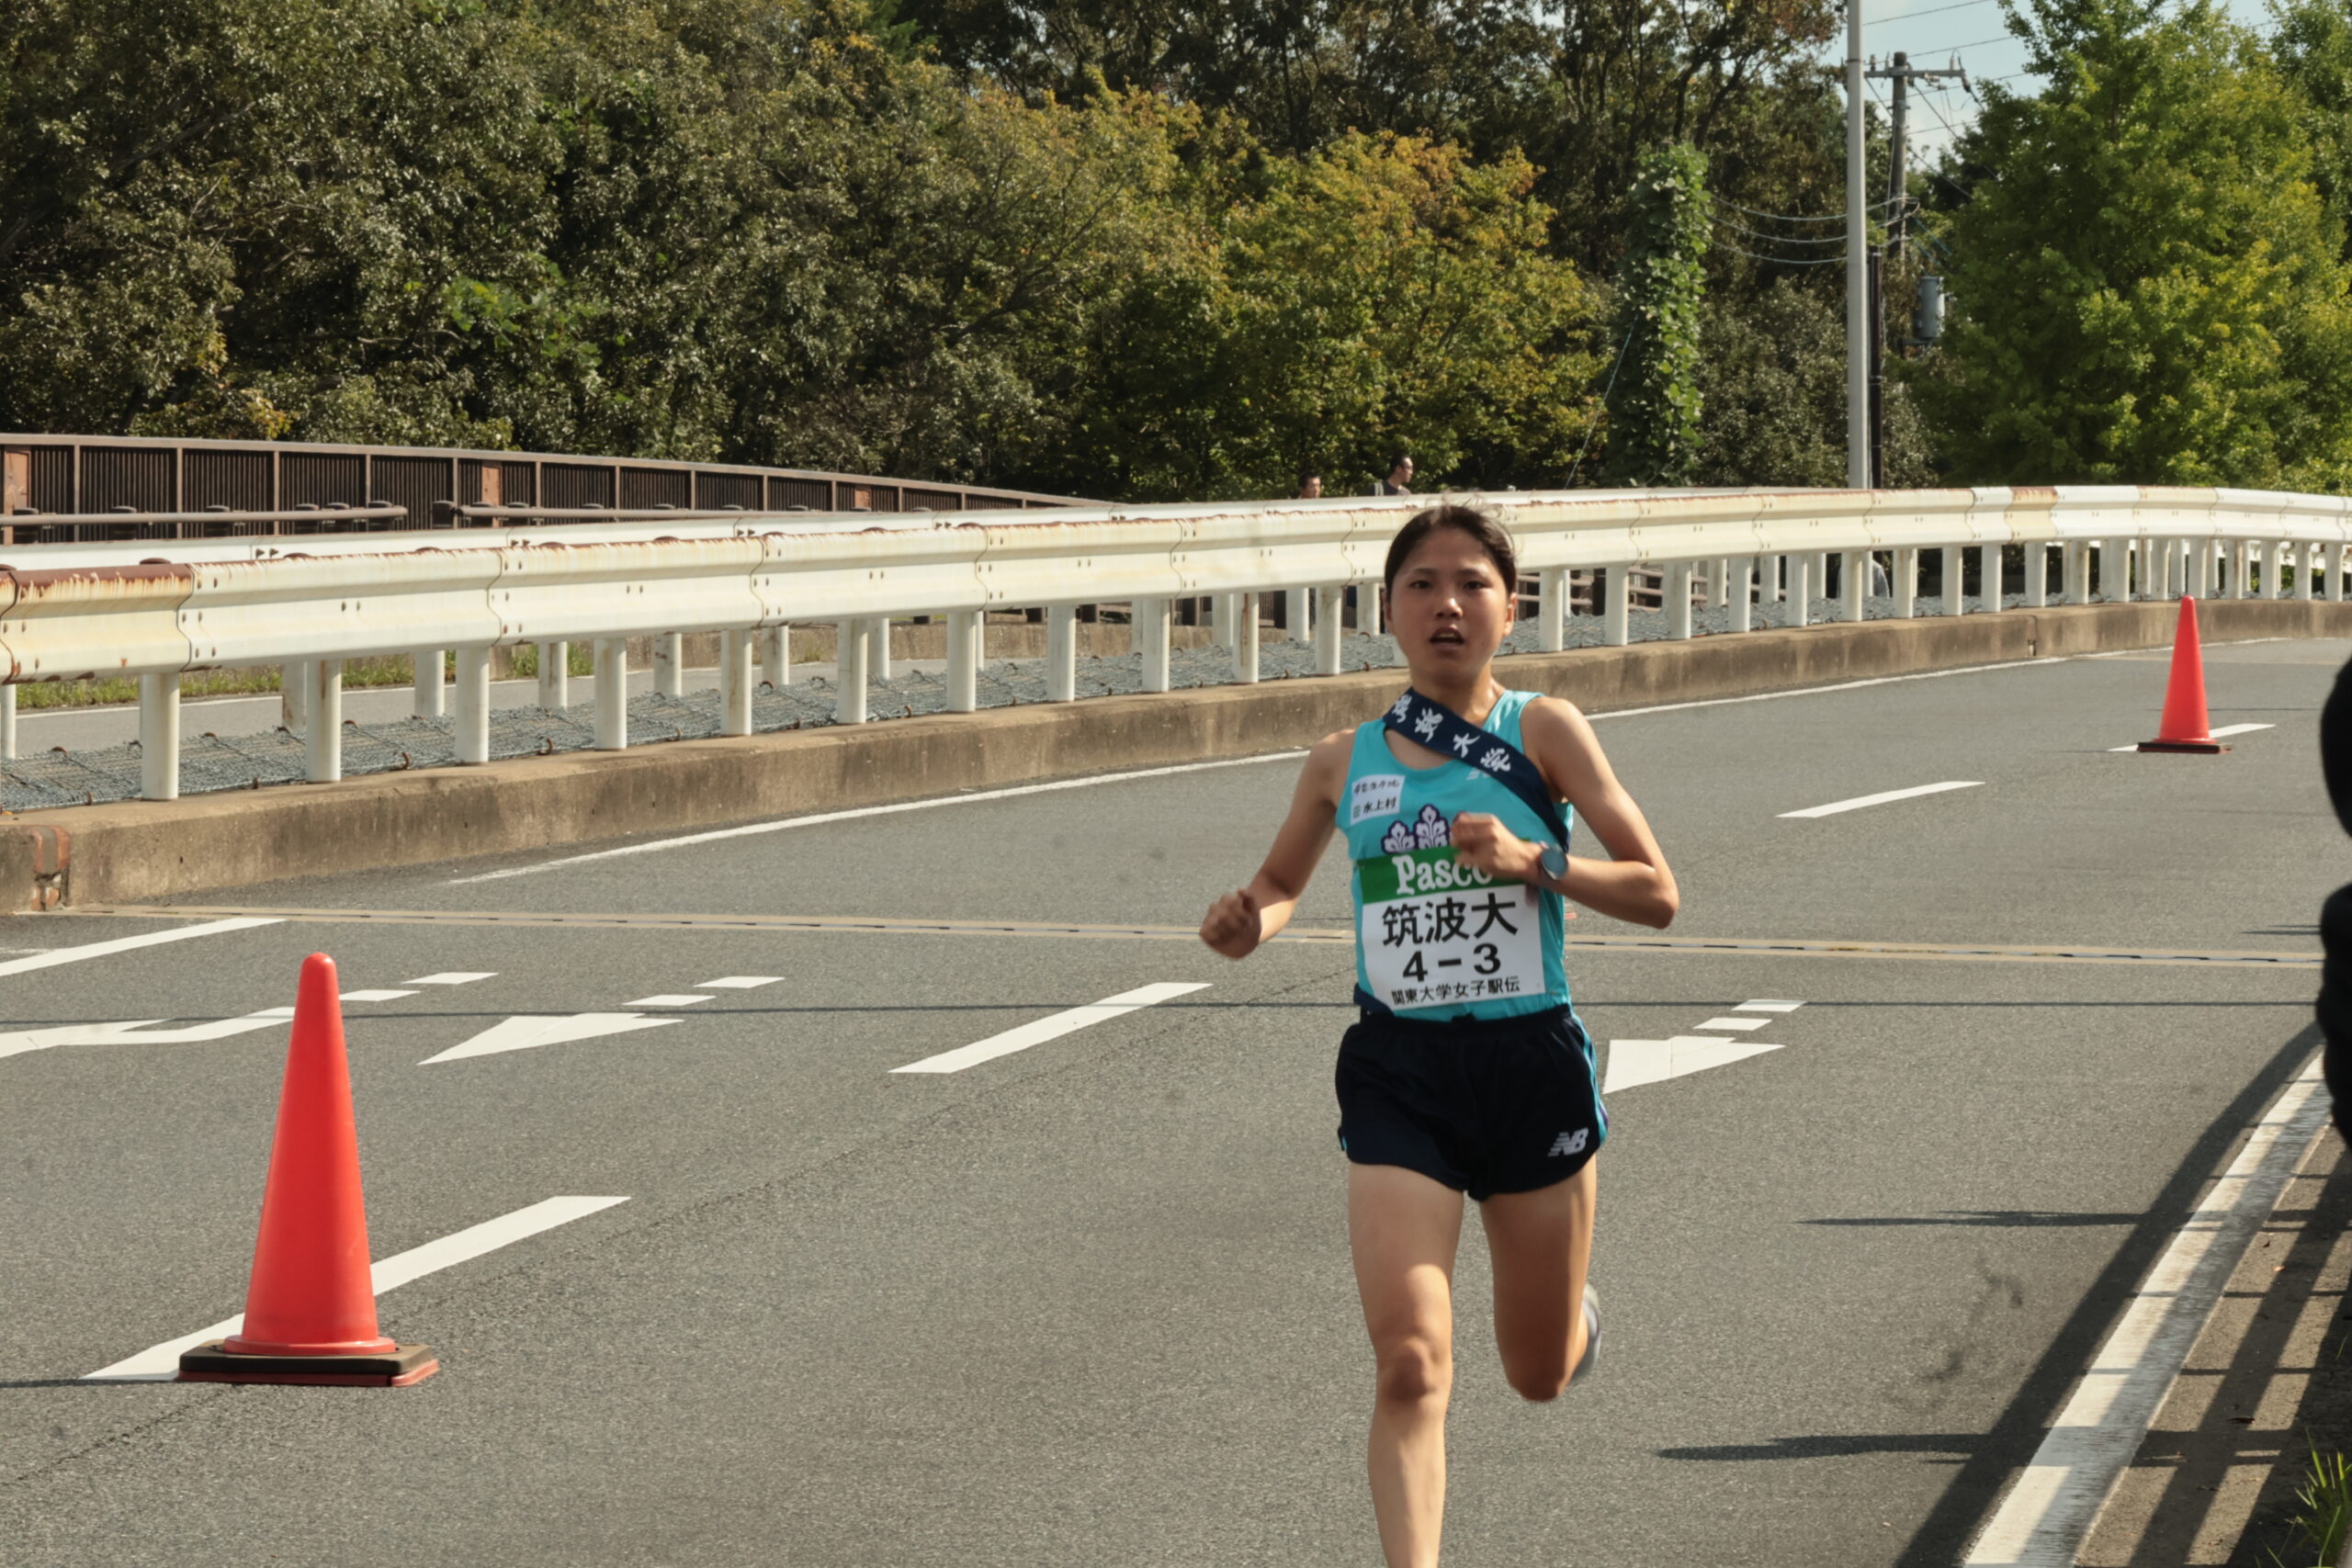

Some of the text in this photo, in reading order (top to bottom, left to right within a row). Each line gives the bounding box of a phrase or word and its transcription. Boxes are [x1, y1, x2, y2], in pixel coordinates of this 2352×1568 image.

[1382, 892, 1518, 948] 筑波大
[1391, 976, 1521, 1006] 関東大学女子駅伝
